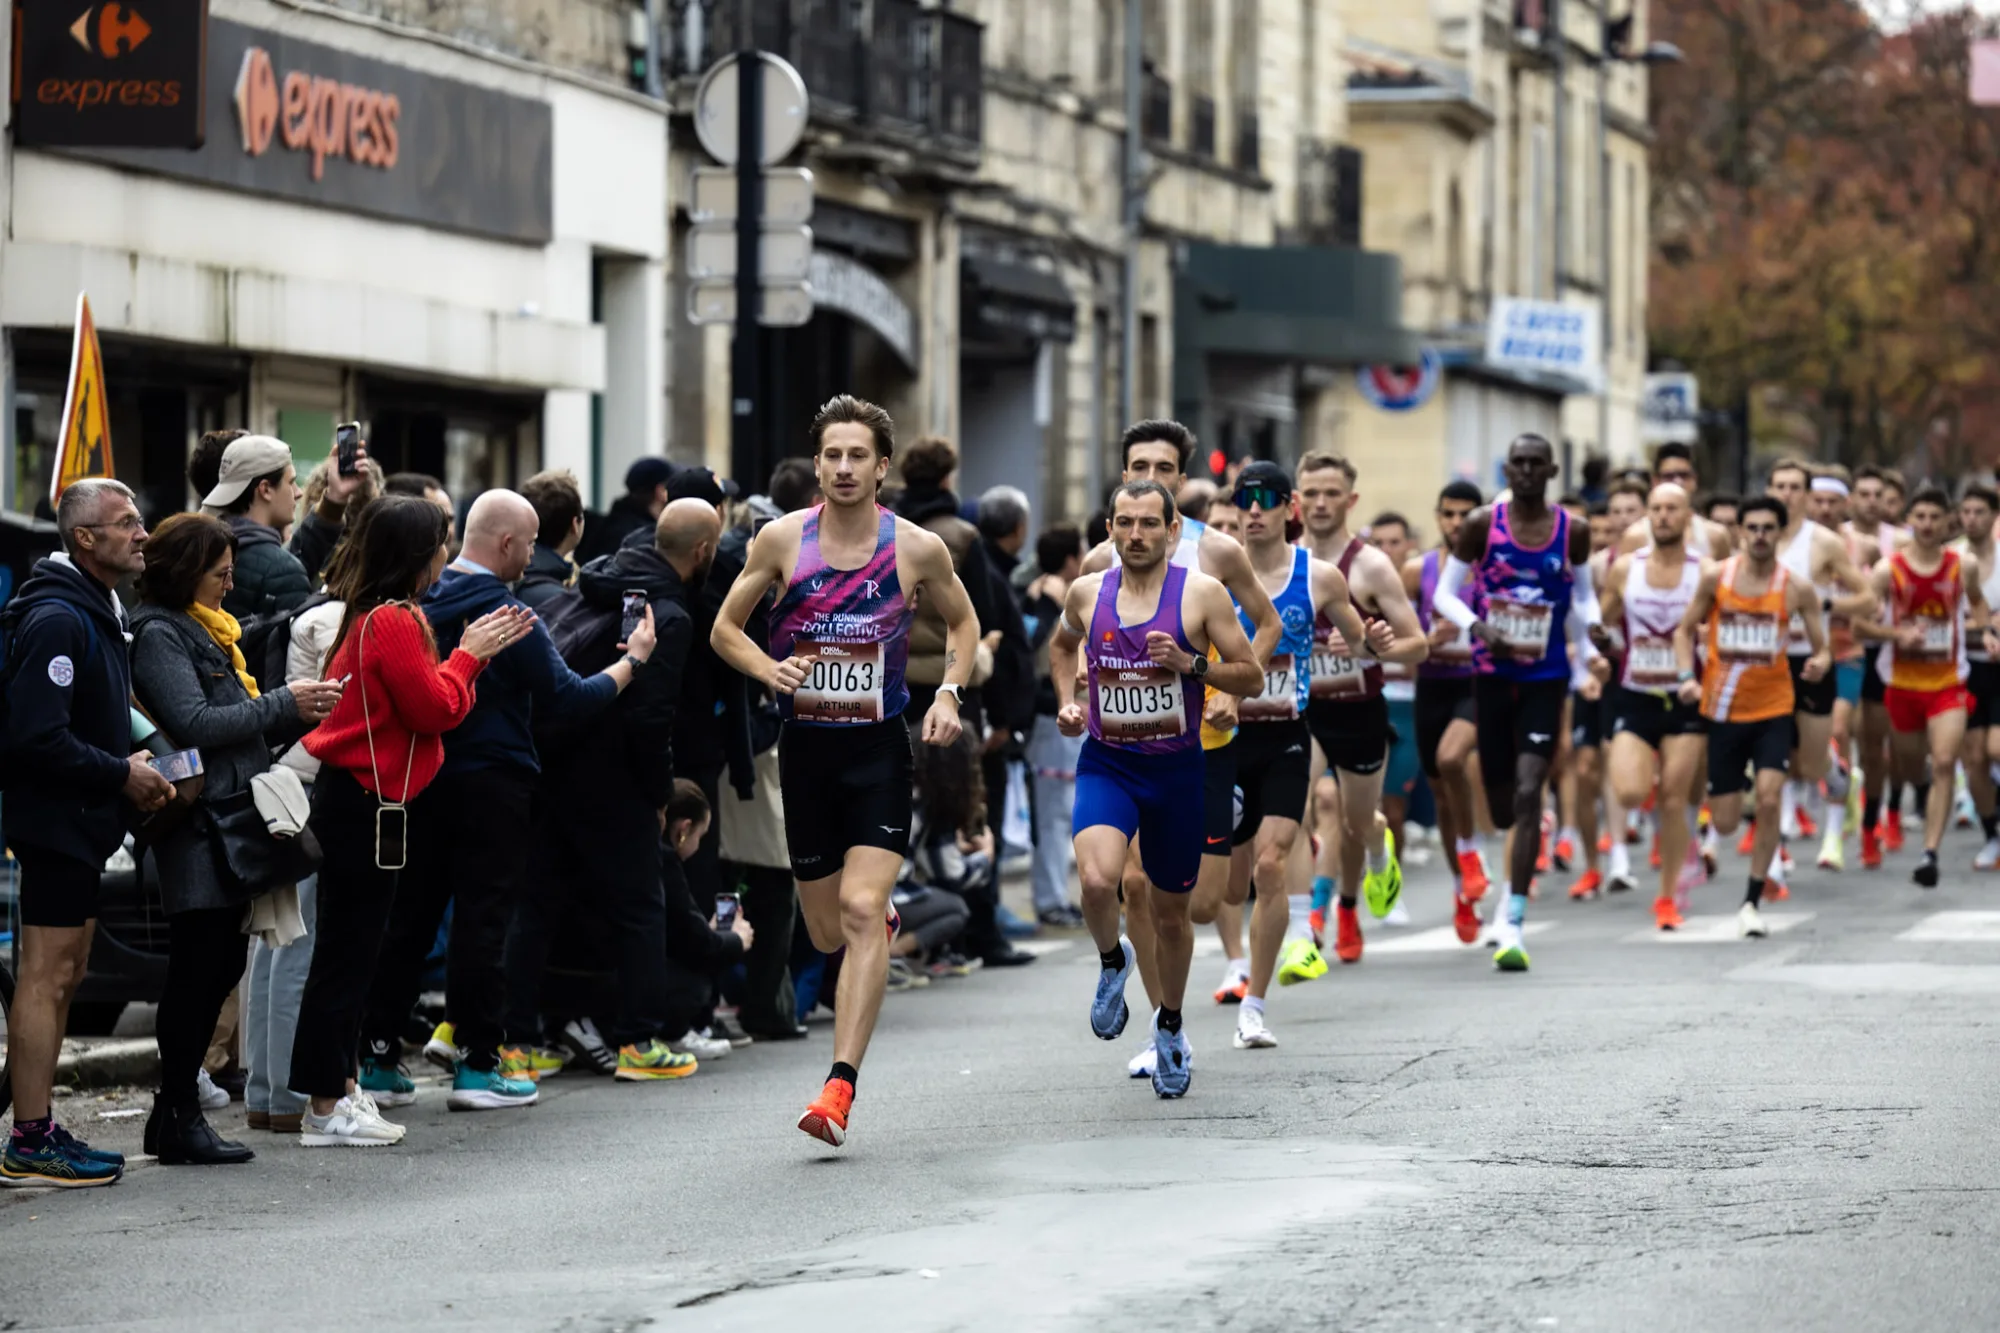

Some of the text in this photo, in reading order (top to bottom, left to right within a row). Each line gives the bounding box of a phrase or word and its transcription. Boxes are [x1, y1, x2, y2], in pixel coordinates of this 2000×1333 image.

[37, 78, 181, 111] express
[281, 71, 400, 181] express
[802, 621, 881, 637] COLLECTIVE
[814, 612, 873, 623] THE RUNNING
[801, 661, 874, 692] 0063
[816, 701, 861, 711] ARTHUR
[1101, 683, 1173, 714] 20035
